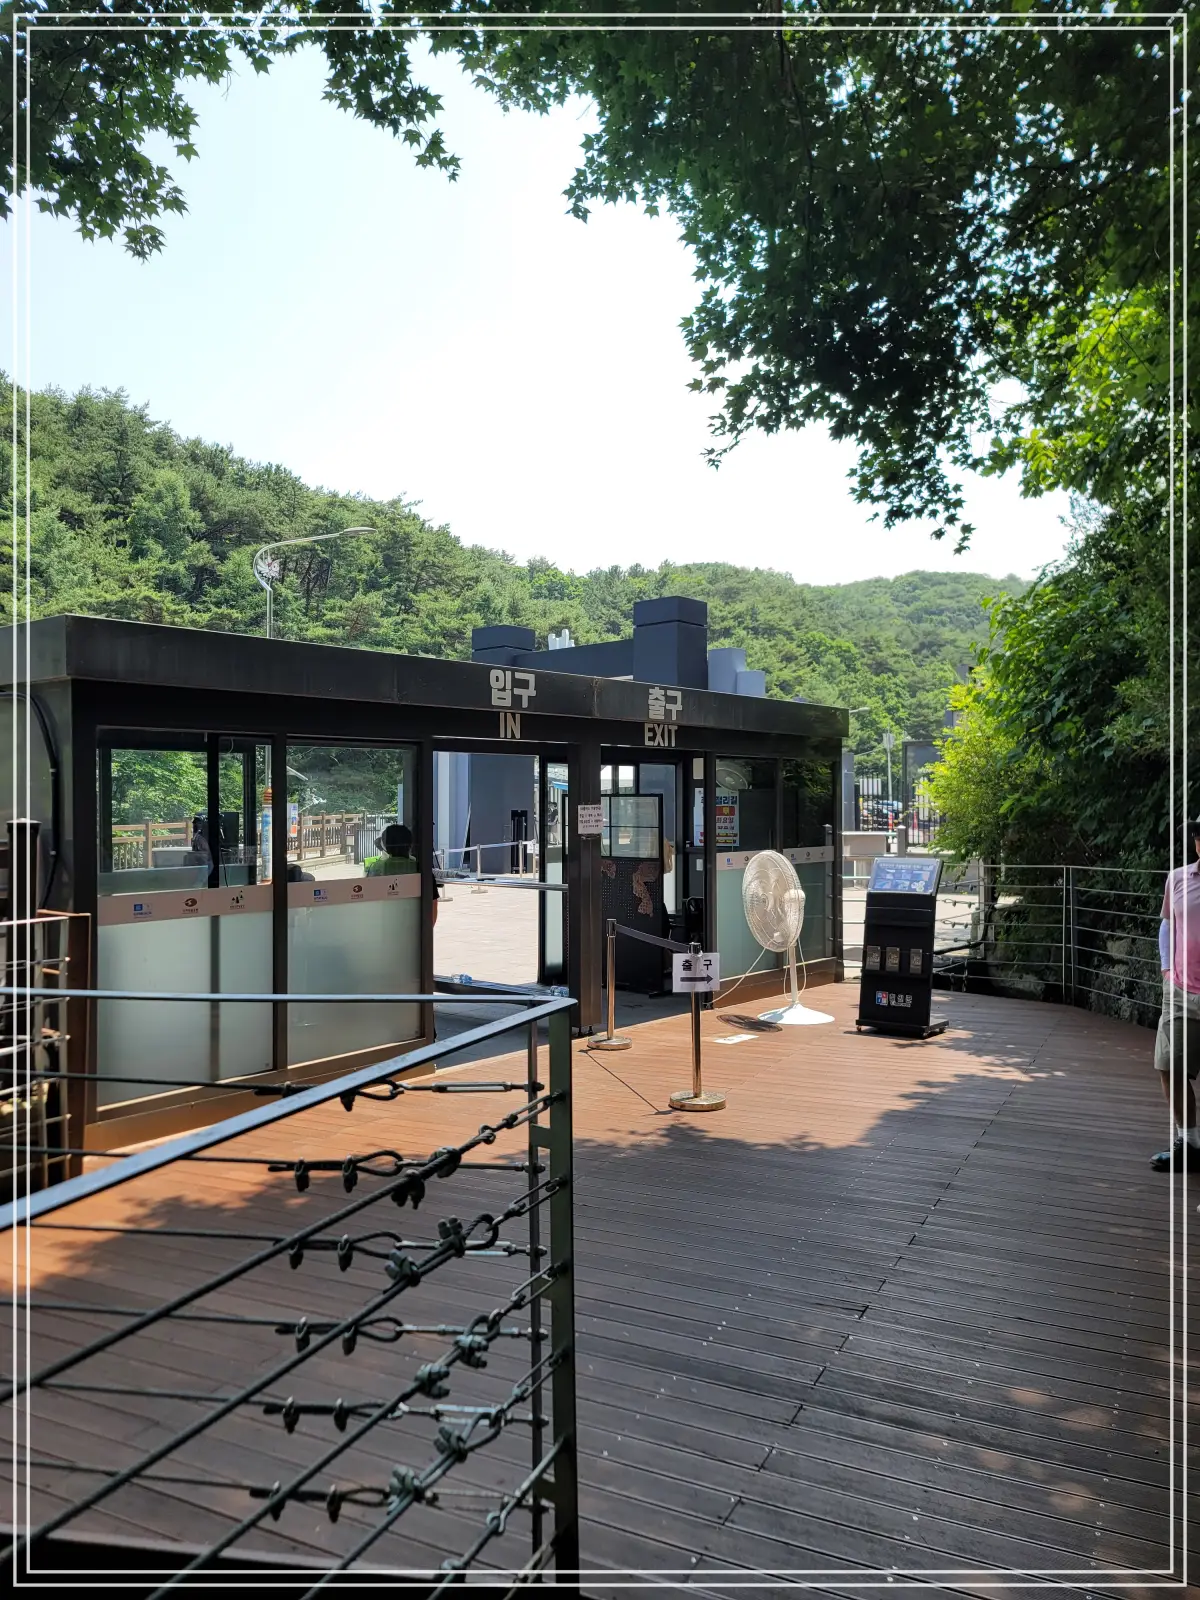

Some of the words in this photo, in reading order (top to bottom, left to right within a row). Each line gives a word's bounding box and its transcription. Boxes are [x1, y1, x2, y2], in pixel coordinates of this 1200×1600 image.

[489, 668, 537, 709] 입구
[647, 686, 683, 721] 출구
[499, 712, 521, 740] IN
[644, 722, 678, 748] EXIT
